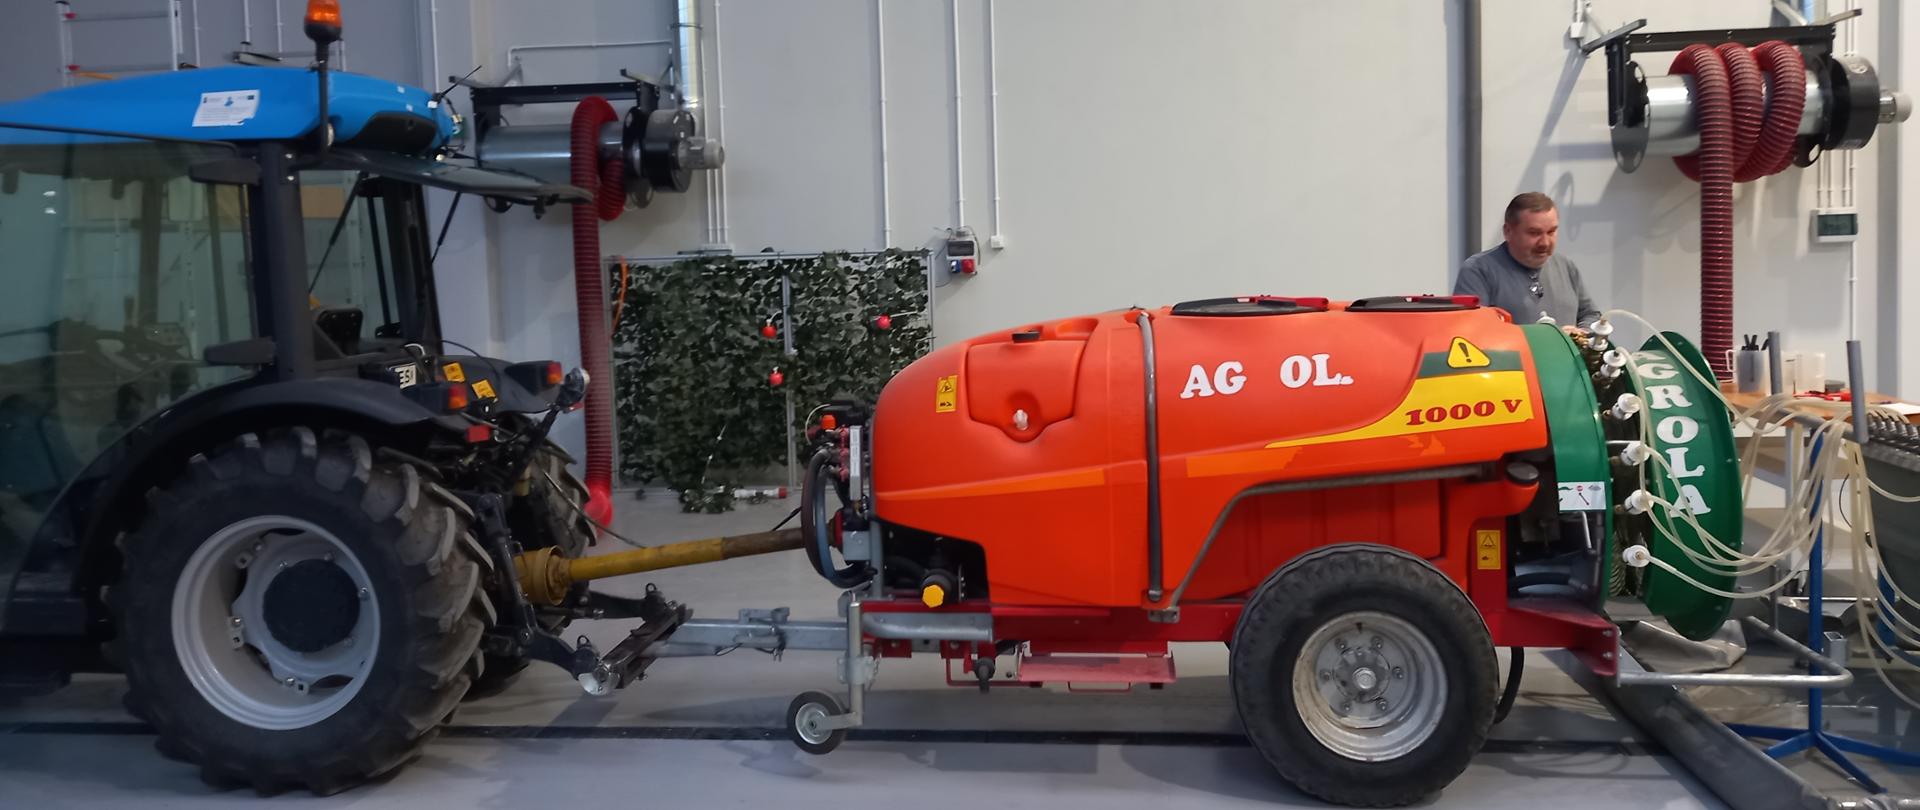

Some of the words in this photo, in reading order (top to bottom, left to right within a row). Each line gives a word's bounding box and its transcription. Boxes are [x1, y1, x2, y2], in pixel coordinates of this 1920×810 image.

[1179, 361, 1248, 399] AG
[1405, 400, 1496, 426] 1000
[1501, 399, 1523, 414] V
